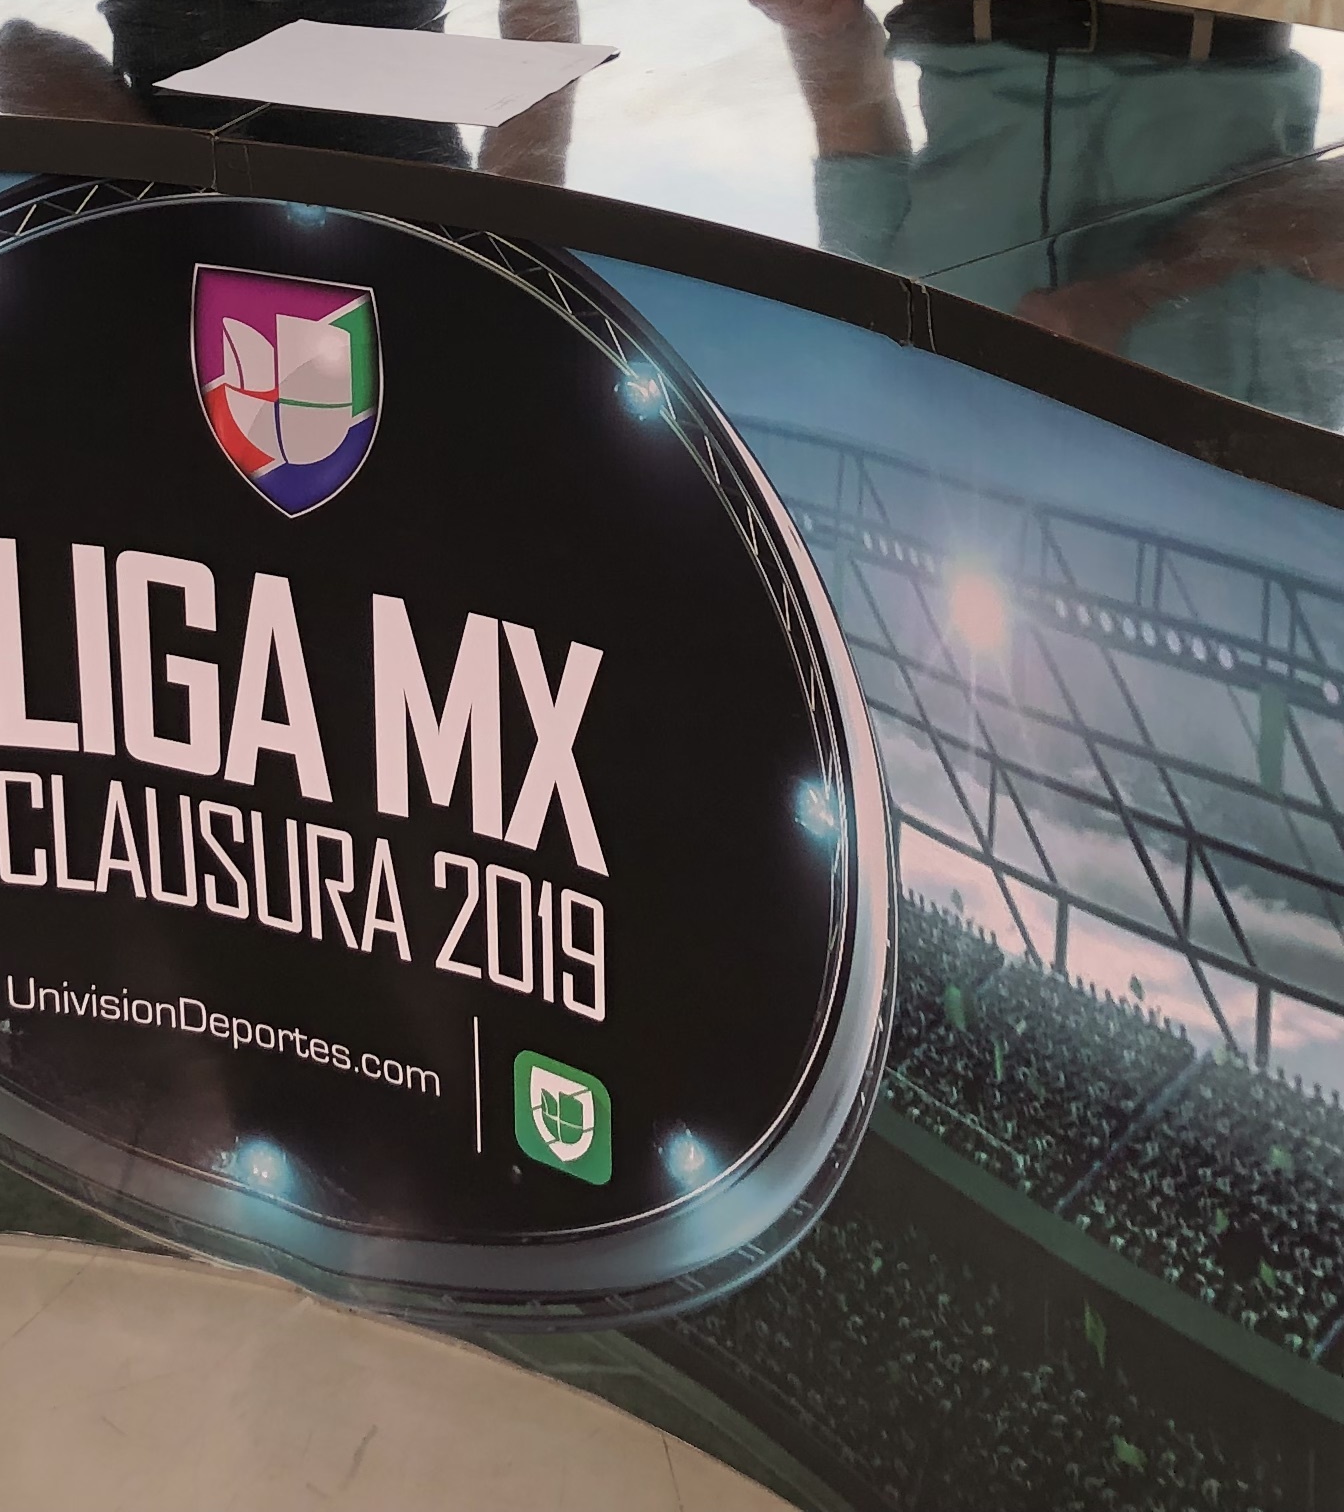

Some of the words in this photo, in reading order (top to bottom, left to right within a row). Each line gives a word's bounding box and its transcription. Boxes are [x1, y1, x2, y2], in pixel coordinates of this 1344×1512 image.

[371, 592, 610, 878] MX
[433, 850, 605, 1022] 2019
[6, 974, 441, 1097] UnivisionDeportes.com
